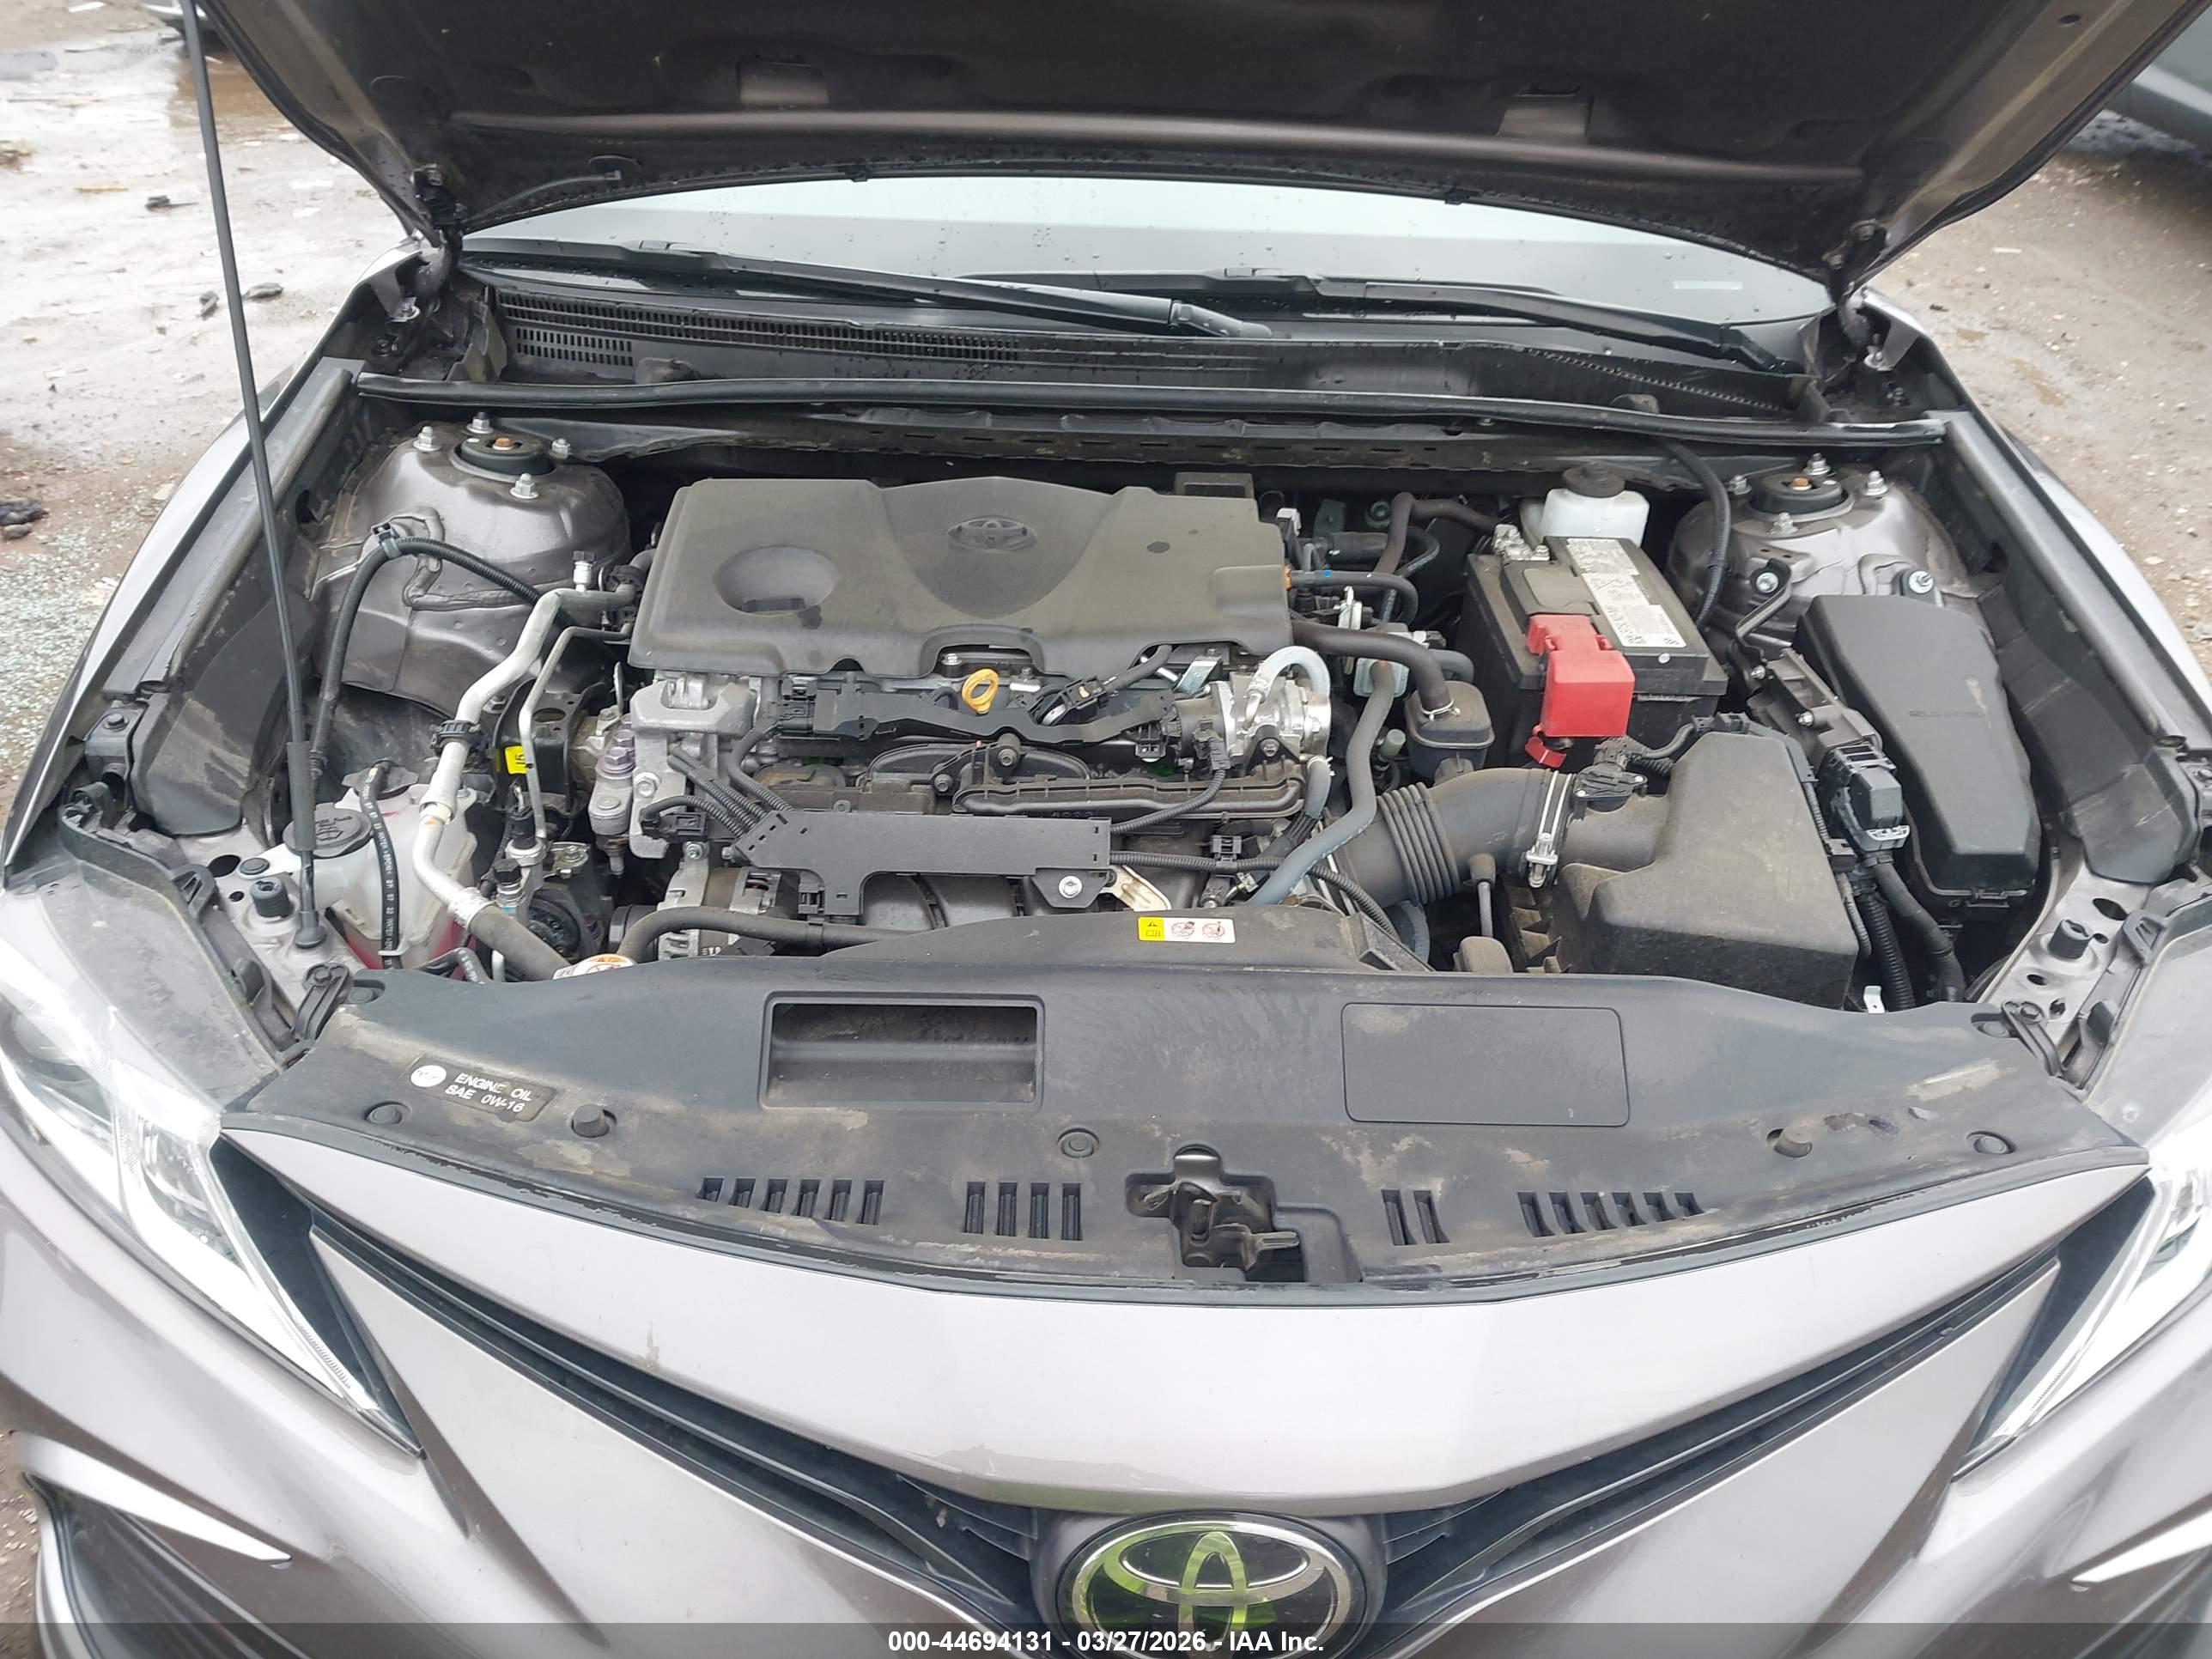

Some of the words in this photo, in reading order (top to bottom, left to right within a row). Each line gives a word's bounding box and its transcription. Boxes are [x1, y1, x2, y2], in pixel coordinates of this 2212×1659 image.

[444, 1085, 477, 1100] SAE
[480, 1095, 526, 1113] 0W-16
[454, 1073, 507, 1094] ENGINE
[510, 1088, 532, 1102] OIL
